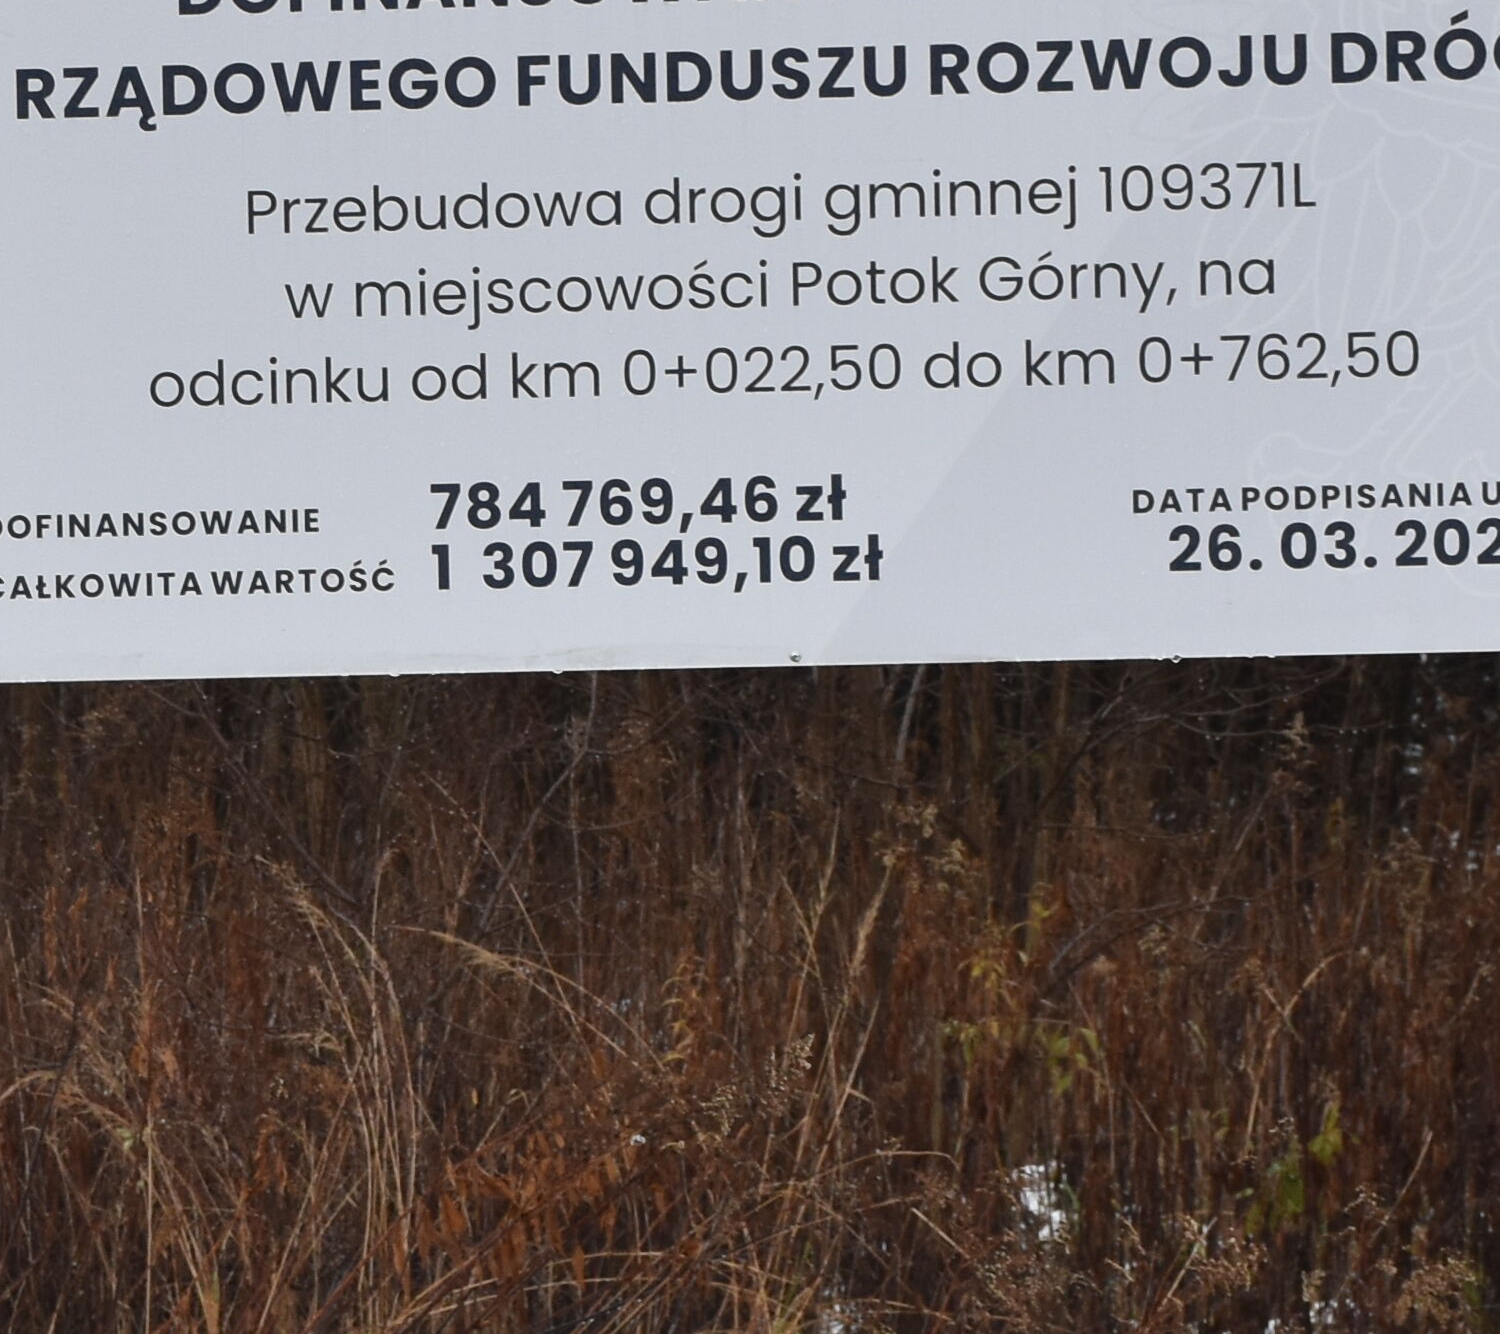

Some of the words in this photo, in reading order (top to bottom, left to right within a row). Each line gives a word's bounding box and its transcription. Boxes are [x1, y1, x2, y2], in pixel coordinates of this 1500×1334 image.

[14, 55, 498, 133] RZĄDOWEGO
[515, 43, 908, 108] FUNDUSZU
[928, 32, 1309, 97] ROZWOJU
[246, 180, 623, 236] Przebudowa
[643, 171, 803, 240] drogi
[823, 163, 1078, 238] gminnej
[1097, 160, 1318, 214] 109371L
[283, 281, 335, 320] w
[354, 257, 769, 332] miejscowości
[791, 254, 961, 308] Potok
[978, 249, 1178, 315] Górny,
[1198, 257, 1276, 298] na
[148, 355, 390, 409] odcinku
[410, 351, 489, 403] od
[510, 350, 602, 400] km
[622, 342, 903, 402] 0+022,50
[922, 339, 1004, 390] do
[1024, 337, 1117, 388] km
[1137, 328, 1421, 389] 0+762,50
[428, 480, 548, 531] 784
[560, 474, 780, 535] 769,46
[794, 472, 848, 523] zł
[1131, 486, 1234, 516] DATA
[1240, 480, 1474, 513] PODPISANIA
[209, 557, 396, 597] WARTOŚĆ
[430, 542, 452, 592] 1
[481, 539, 595, 591] 307
[609, 534, 817, 595] 949,10
[831, 532, 885, 583] zł
[1167, 522, 1264, 573] 26.
[1279, 519, 1379, 571] 03.
